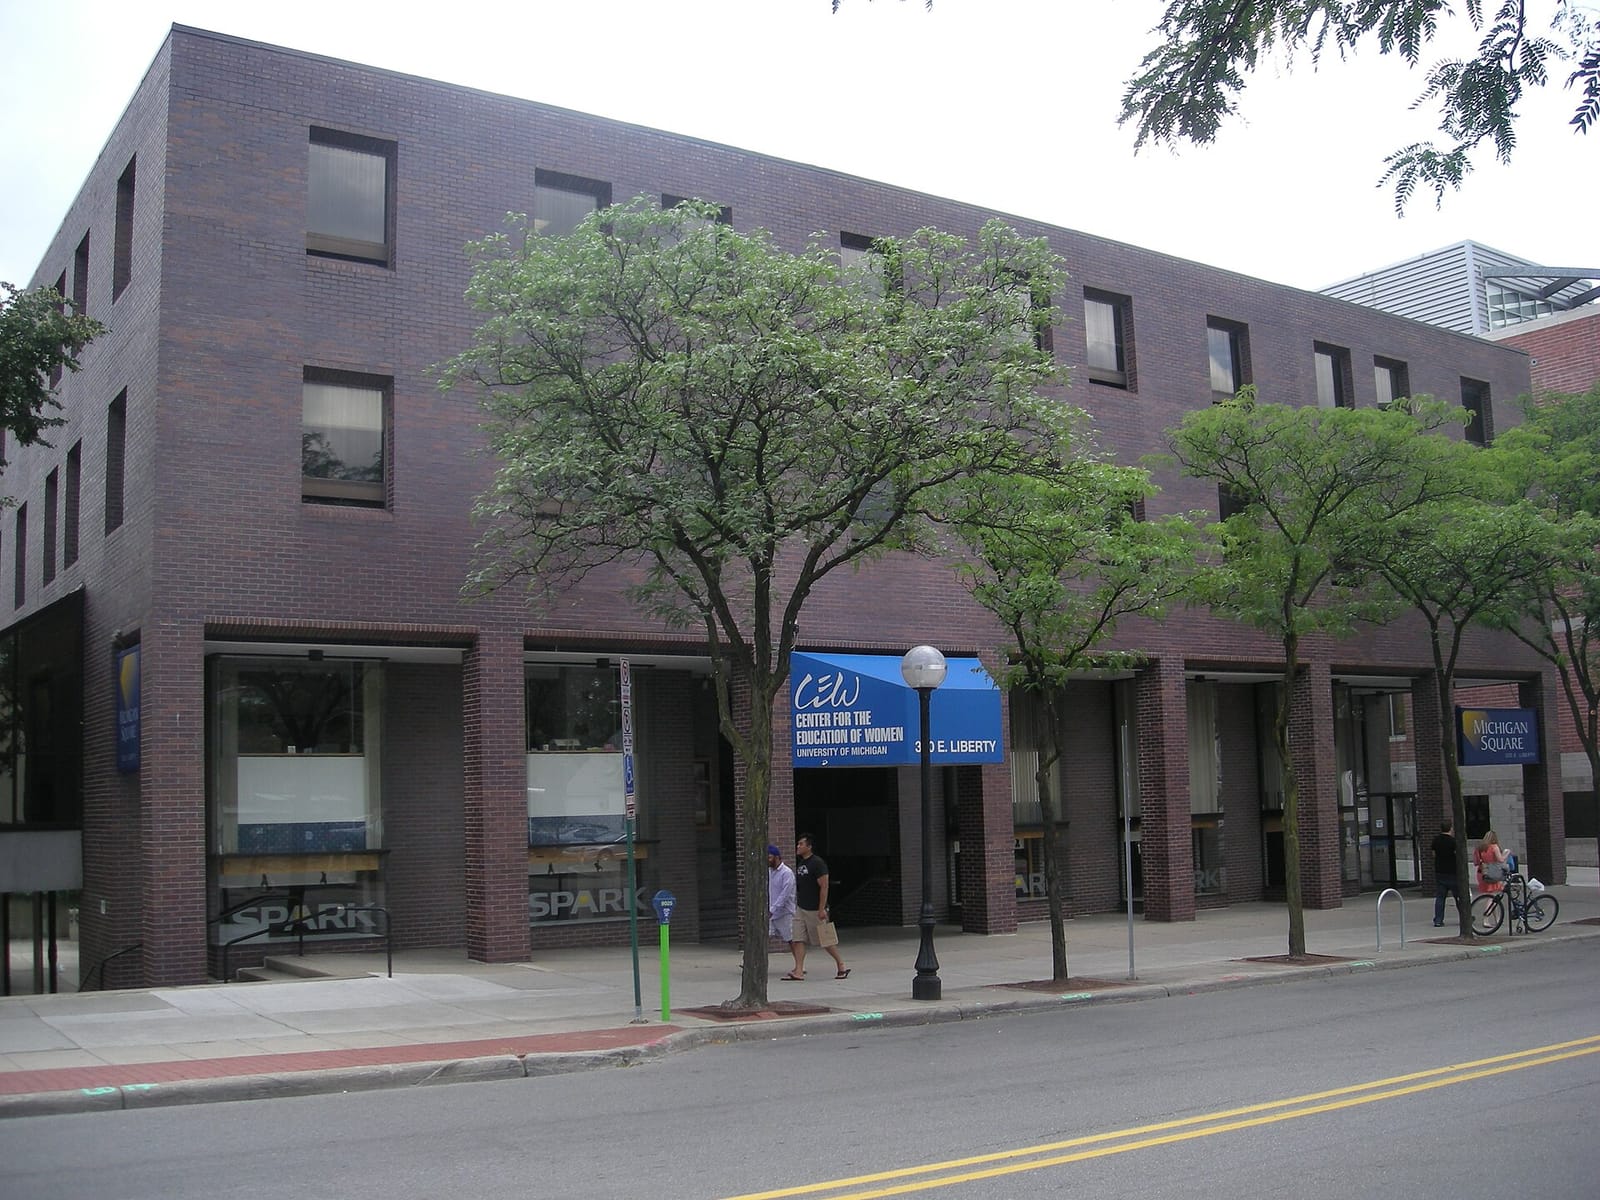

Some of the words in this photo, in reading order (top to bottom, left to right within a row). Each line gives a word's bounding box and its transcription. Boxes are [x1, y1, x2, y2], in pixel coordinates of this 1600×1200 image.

[796, 712, 831, 728] CENTER
[833, 711, 851, 727] FOR
[853, 710, 872, 726] THE
[1473, 720, 1529, 735] MICHIGAN
[796, 729, 848, 745] EDUCATION
[850, 728, 862, 744] OF
[864, 727, 904, 743] WOMEN
[1480, 735, 1525, 753] SQUARE
[796, 747, 838, 758] UNIVERSITY
[840, 746, 850, 757] OF
[851, 745, 887, 756] MICHIGAN
[915, 740, 935, 753] 30
[937, 740, 948, 753] E.
[950, 740, 996, 753] LIBERTY
[528, 887, 648, 917] SPARK
[232, 902, 377, 932] SPARK
